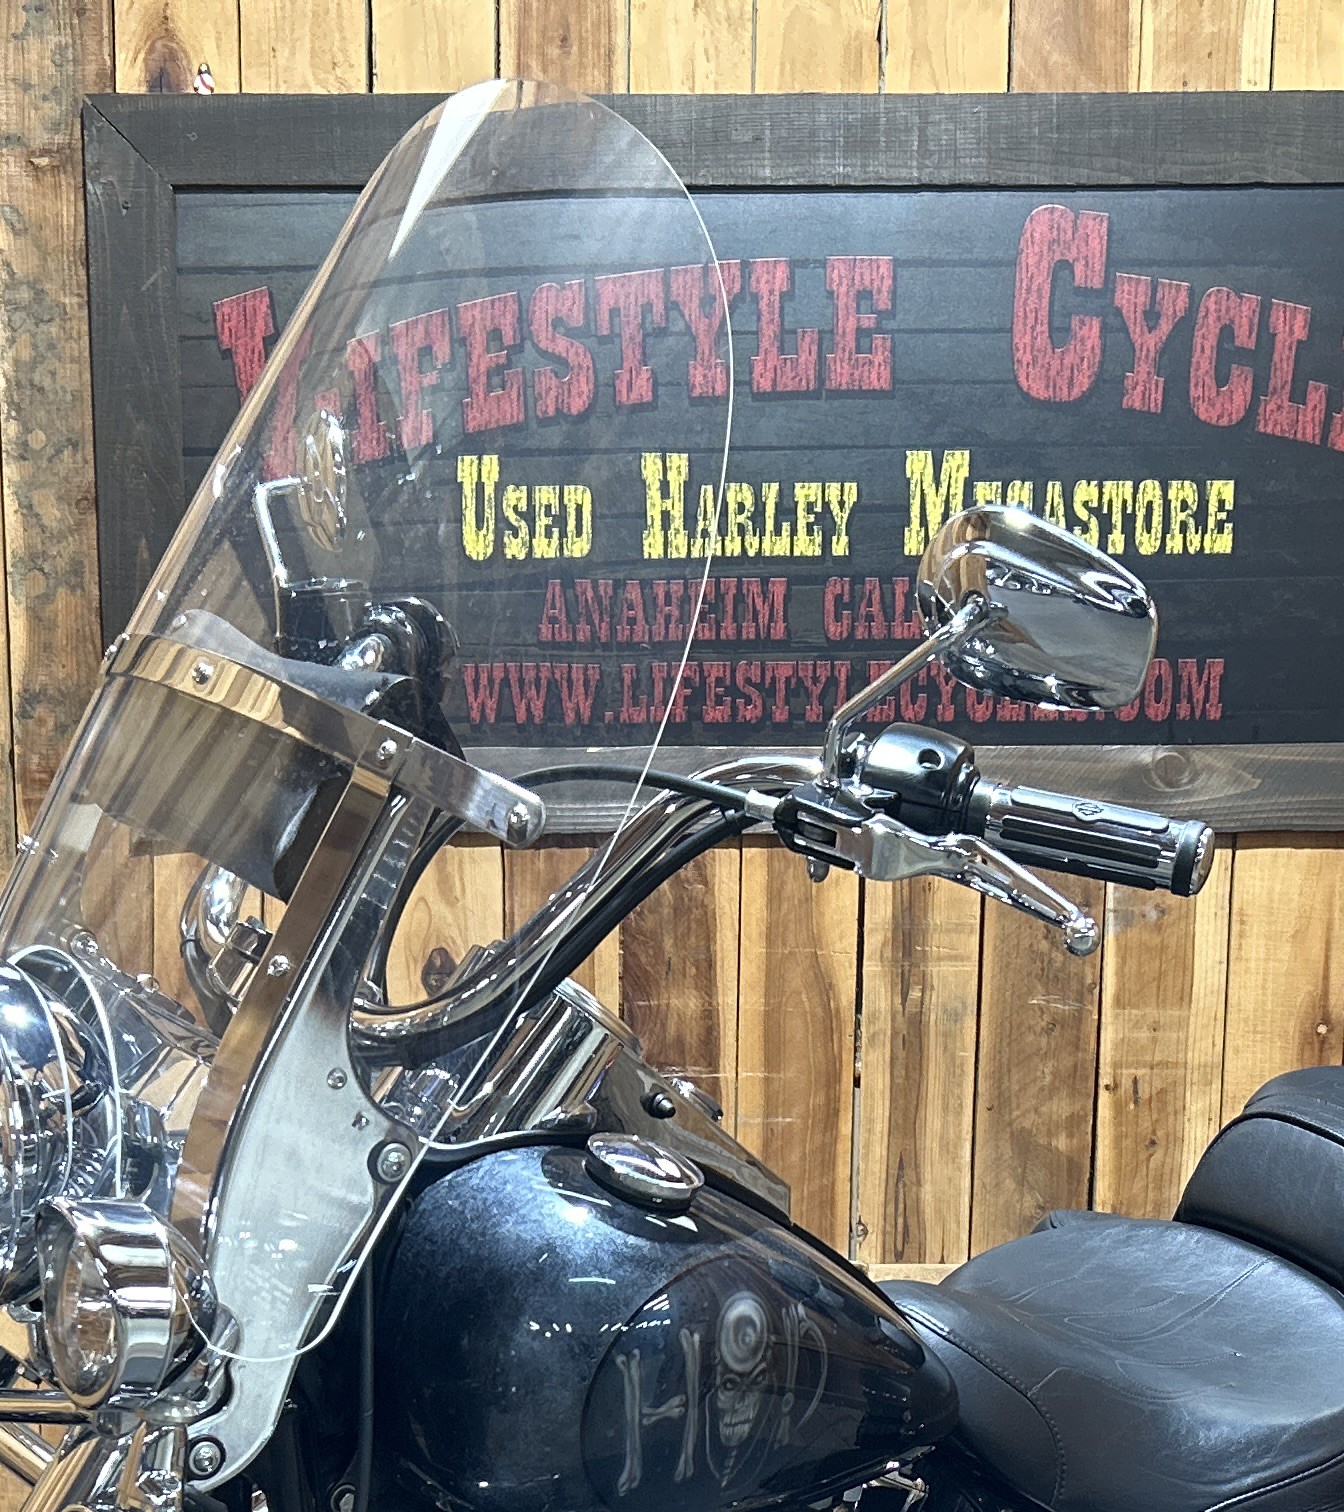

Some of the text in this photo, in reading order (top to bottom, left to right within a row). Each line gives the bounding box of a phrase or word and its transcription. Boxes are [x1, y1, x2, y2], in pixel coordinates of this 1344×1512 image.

[213, 255, 894, 482] LIFESTYLE
[456, 454, 593, 561] USED
[640, 452, 859, 559] HARLEY
[537, 577, 788, 643] ANAHEIM
